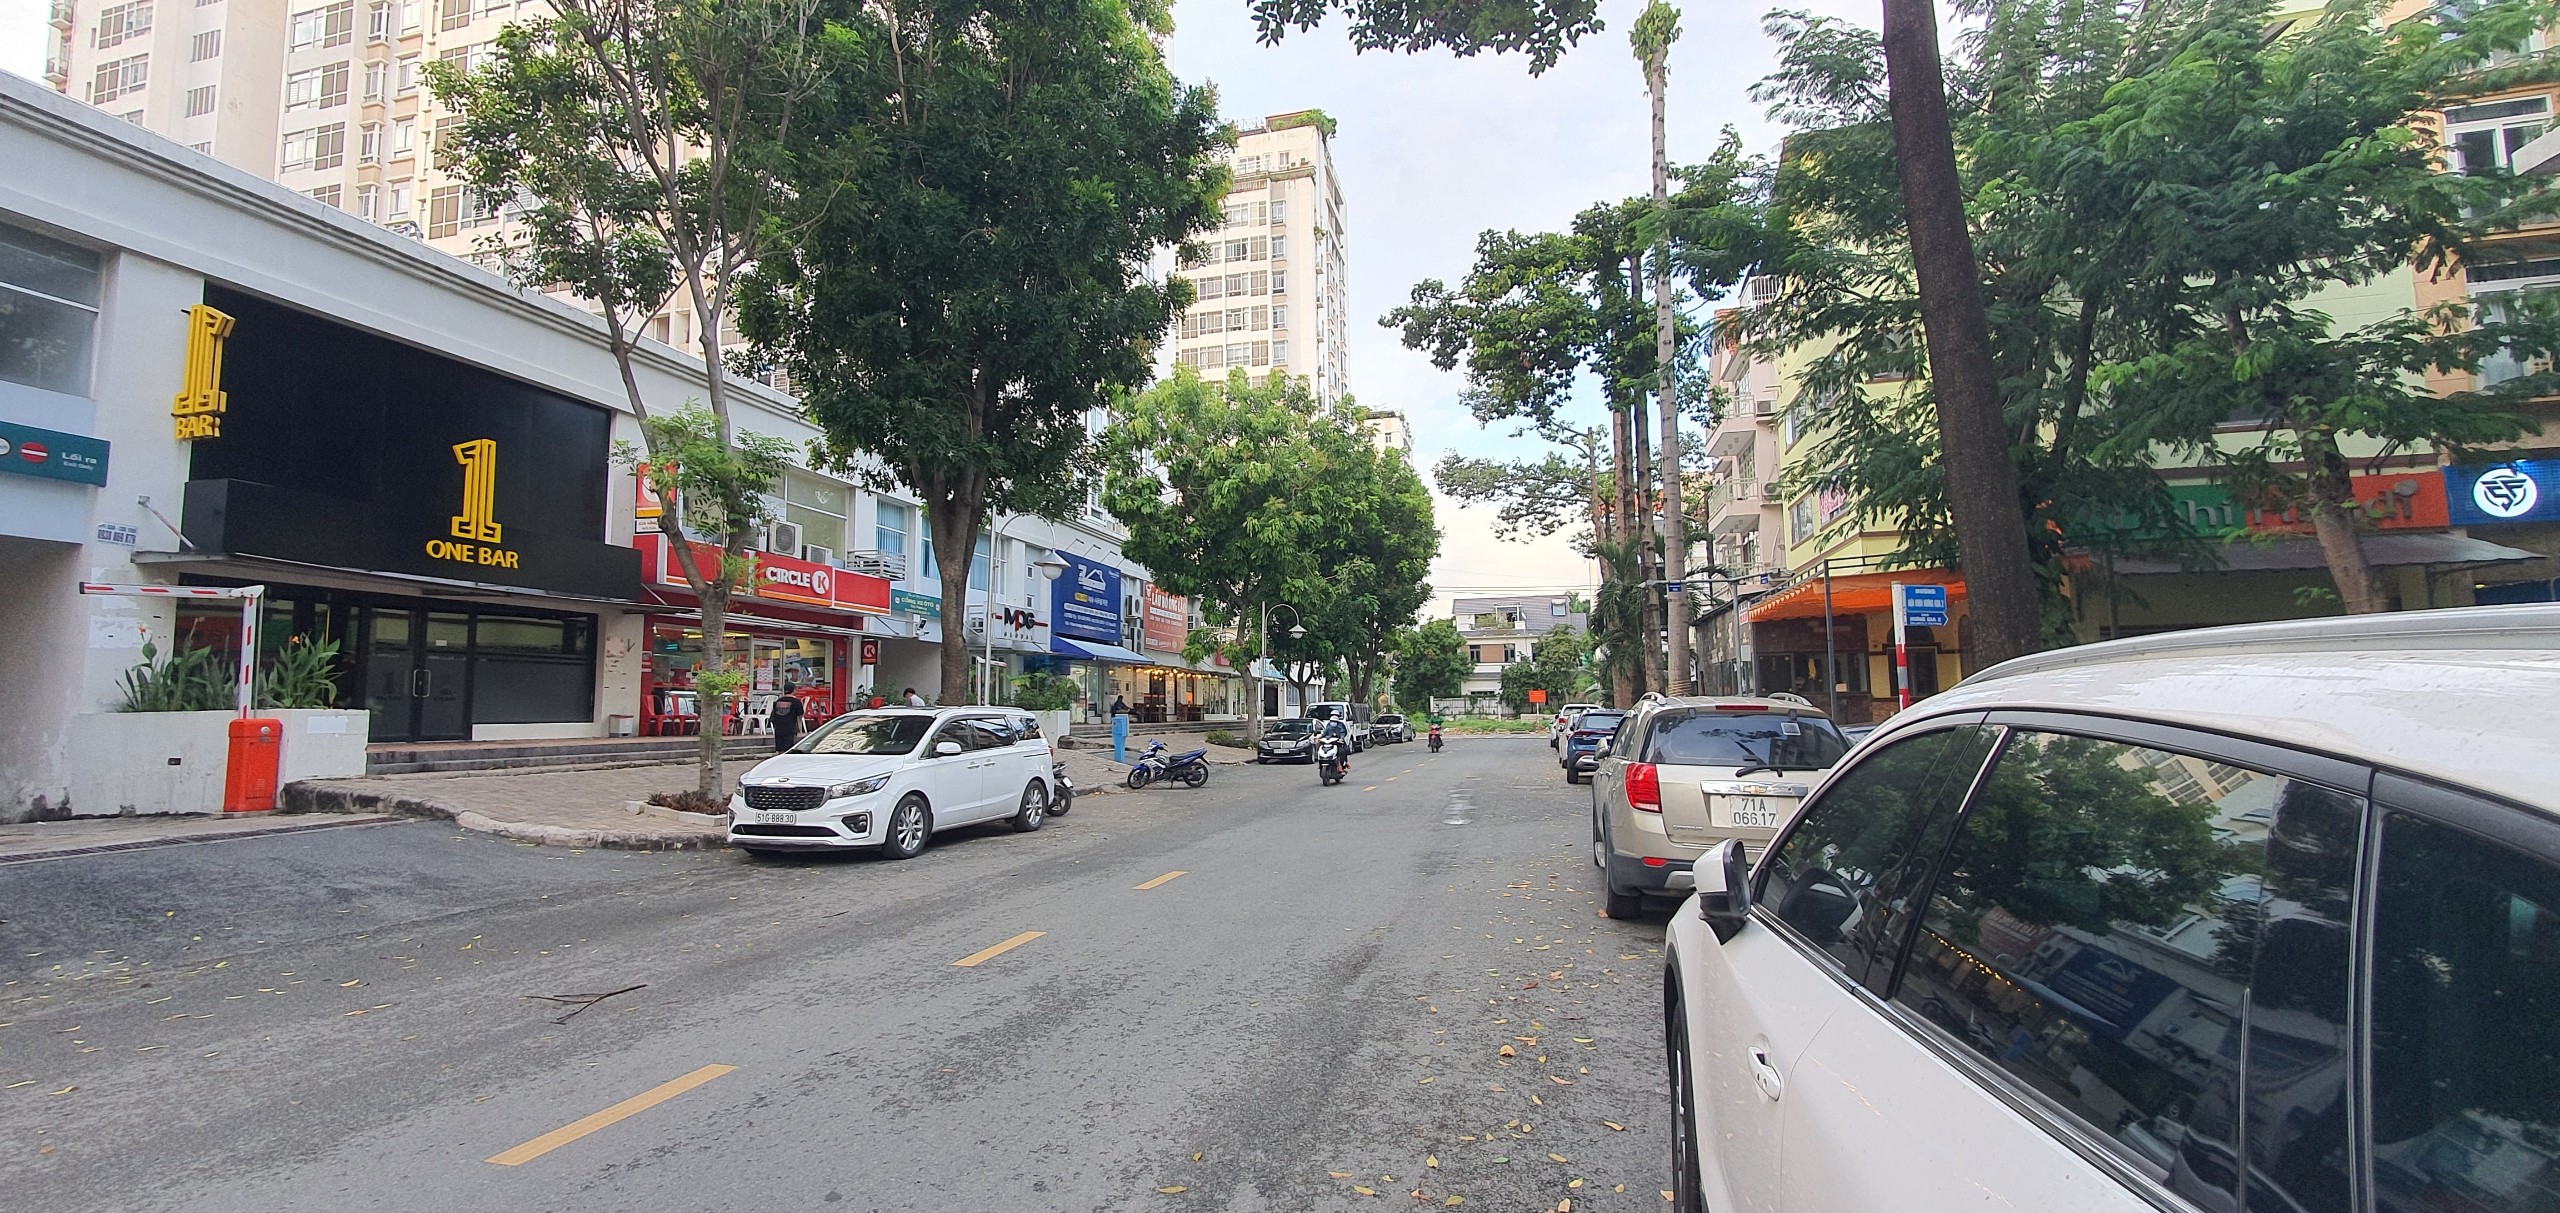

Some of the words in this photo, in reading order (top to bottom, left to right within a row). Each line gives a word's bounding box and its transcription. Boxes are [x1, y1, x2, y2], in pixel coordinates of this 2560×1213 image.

[85, 456, 97, 464] ra
[426, 539, 475, 563] ONE
[477, 547, 519, 569] BAR
[765, 566, 811, 588] CIRCLE
[814, 572, 829, 594] K
[1741, 798, 1767, 812] 71A
[757, 813, 794, 823] 51G-88830
[1733, 812, 1777, 827] 066.17
